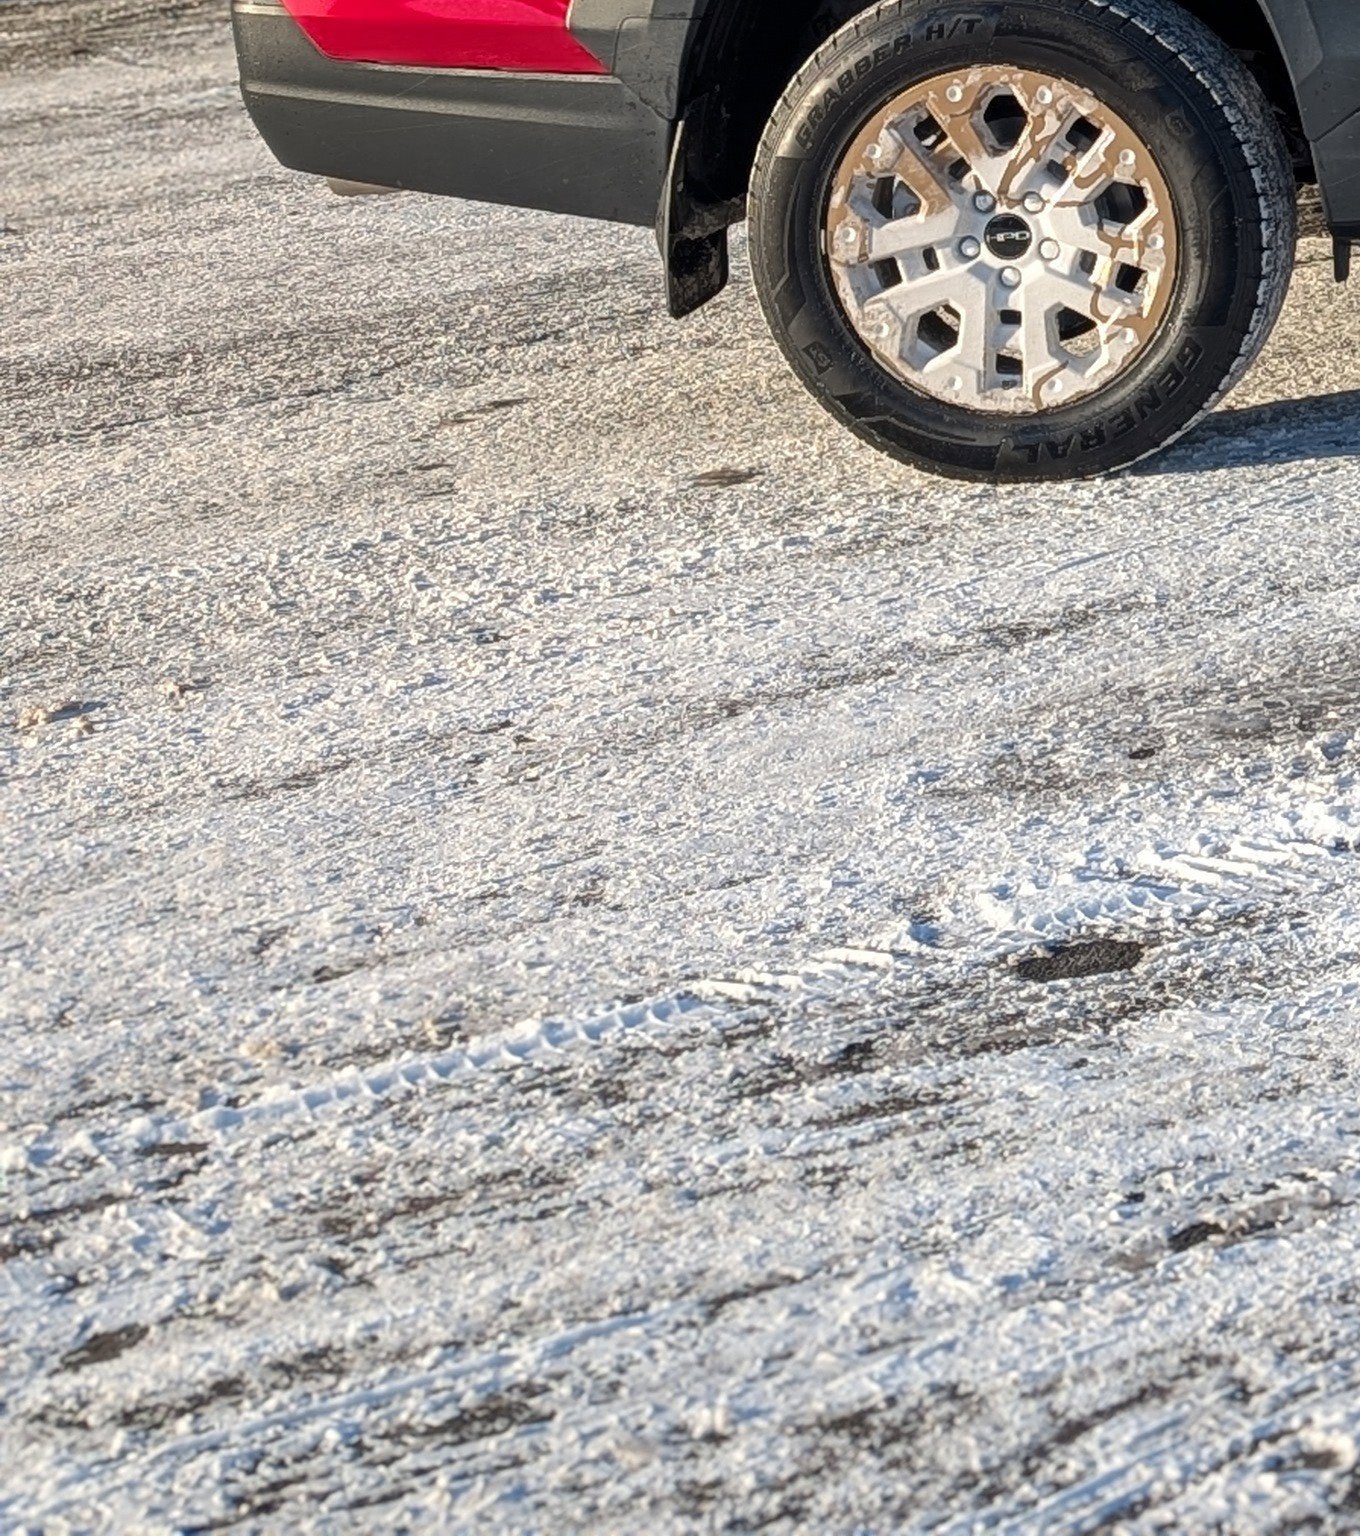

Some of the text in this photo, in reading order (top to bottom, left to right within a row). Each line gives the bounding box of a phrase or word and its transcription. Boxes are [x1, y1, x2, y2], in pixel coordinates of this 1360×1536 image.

[794, 17, 983, 149] GRABBER H/T
[986, 231, 1030, 243] HPD
[1012, 337, 1205, 465] GENERAL
